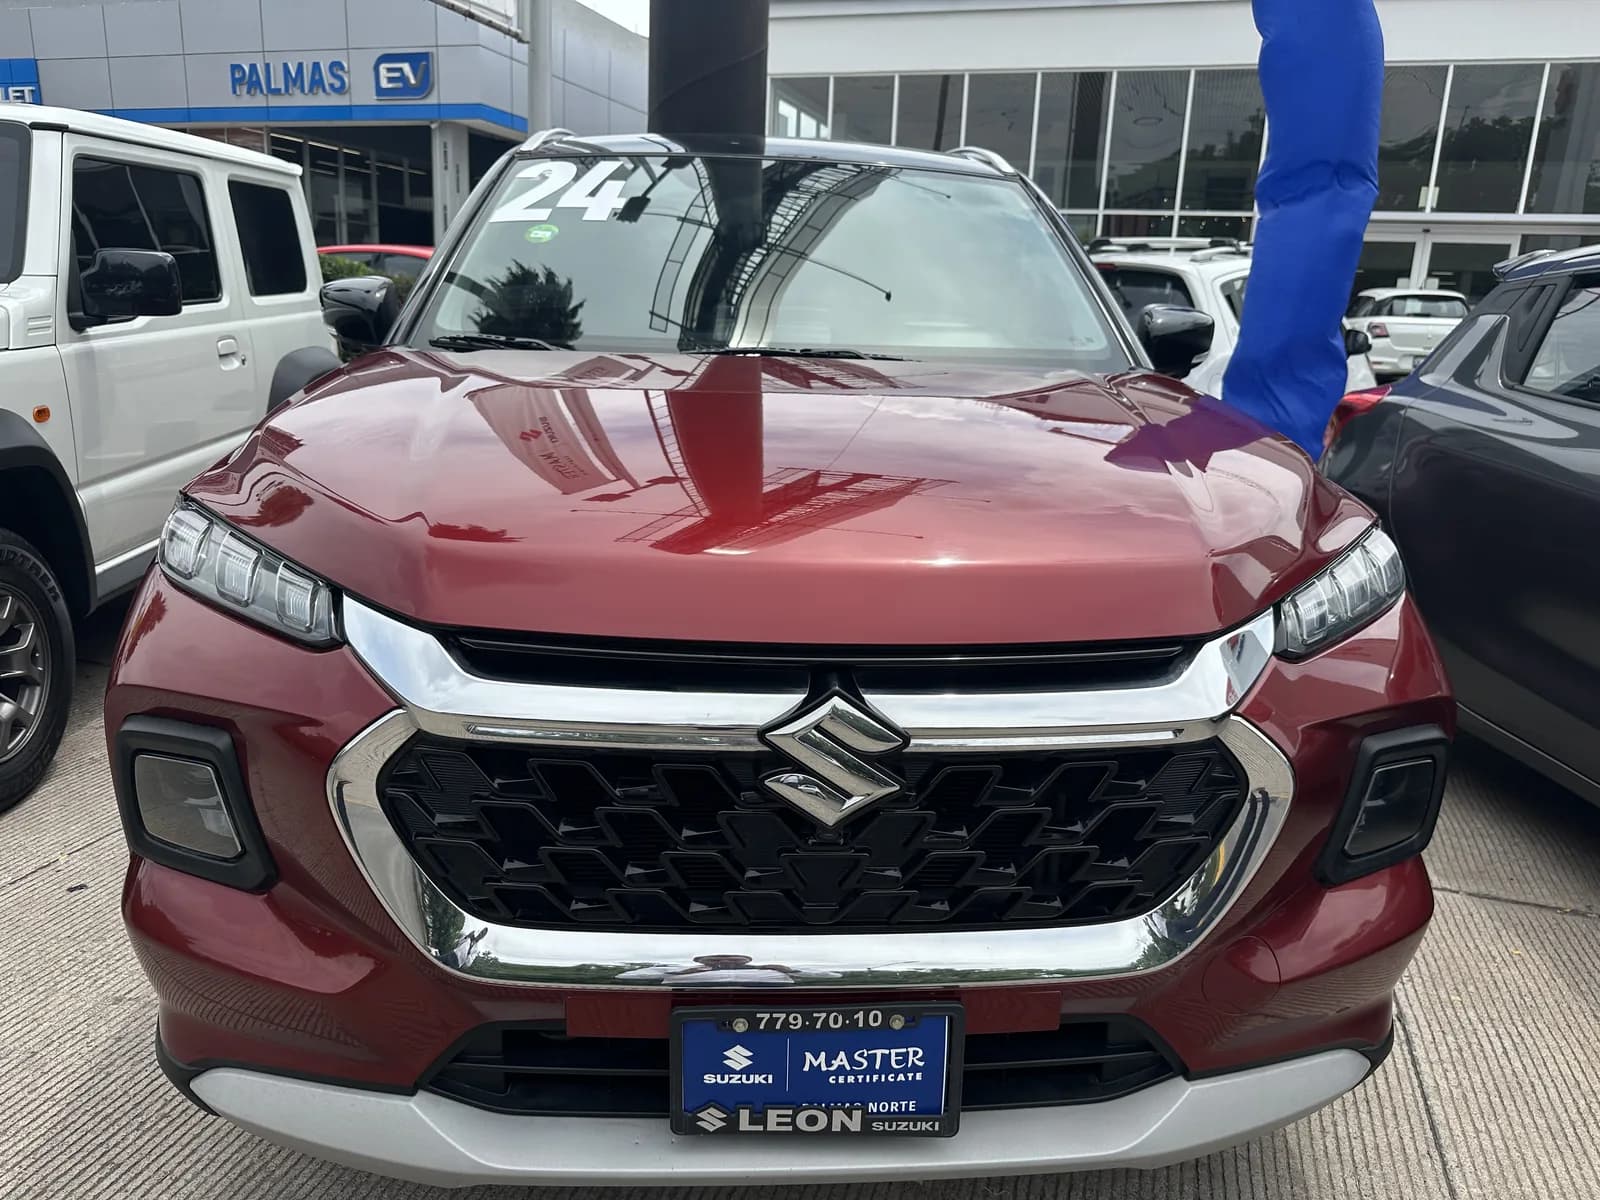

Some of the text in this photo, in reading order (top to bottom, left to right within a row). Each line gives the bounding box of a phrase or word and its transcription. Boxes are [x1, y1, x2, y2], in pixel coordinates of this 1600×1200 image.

[229, 60, 350, 96] PALMAS
[378, 62, 427, 89] EV
[488, 160, 627, 222] 24
[803, 1047, 925, 1072] MASTER
[703, 1073, 773, 1084] SUZUKI
[829, 1072, 923, 1084] CERTIFICATE
[868, 1100, 917, 1113] NORTE
[738, 1108, 940, 1132] LEON SUZUKI
